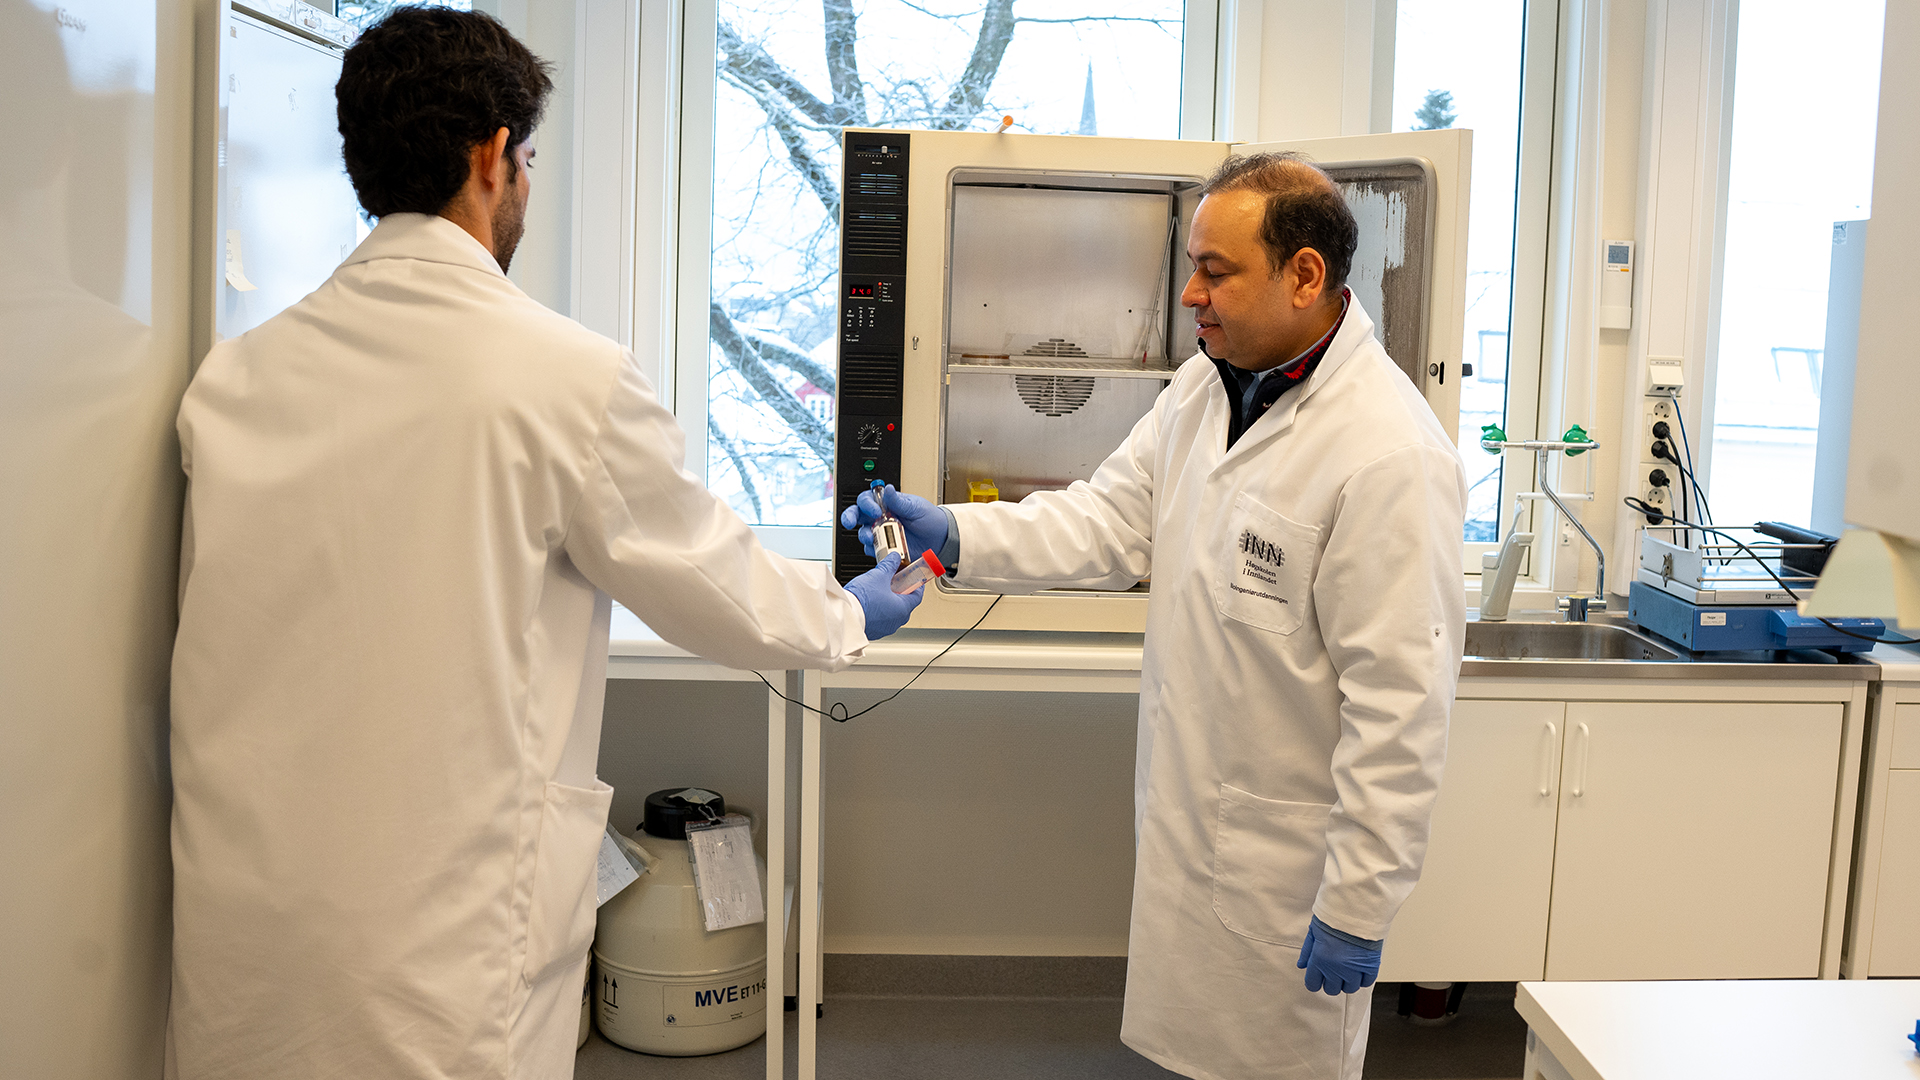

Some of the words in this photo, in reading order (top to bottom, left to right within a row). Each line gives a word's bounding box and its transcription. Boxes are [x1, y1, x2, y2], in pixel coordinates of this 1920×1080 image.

[1246, 568, 1277, 586] Innlandet
[695, 985, 739, 1008] MVE
[740, 986, 750, 999] ET
